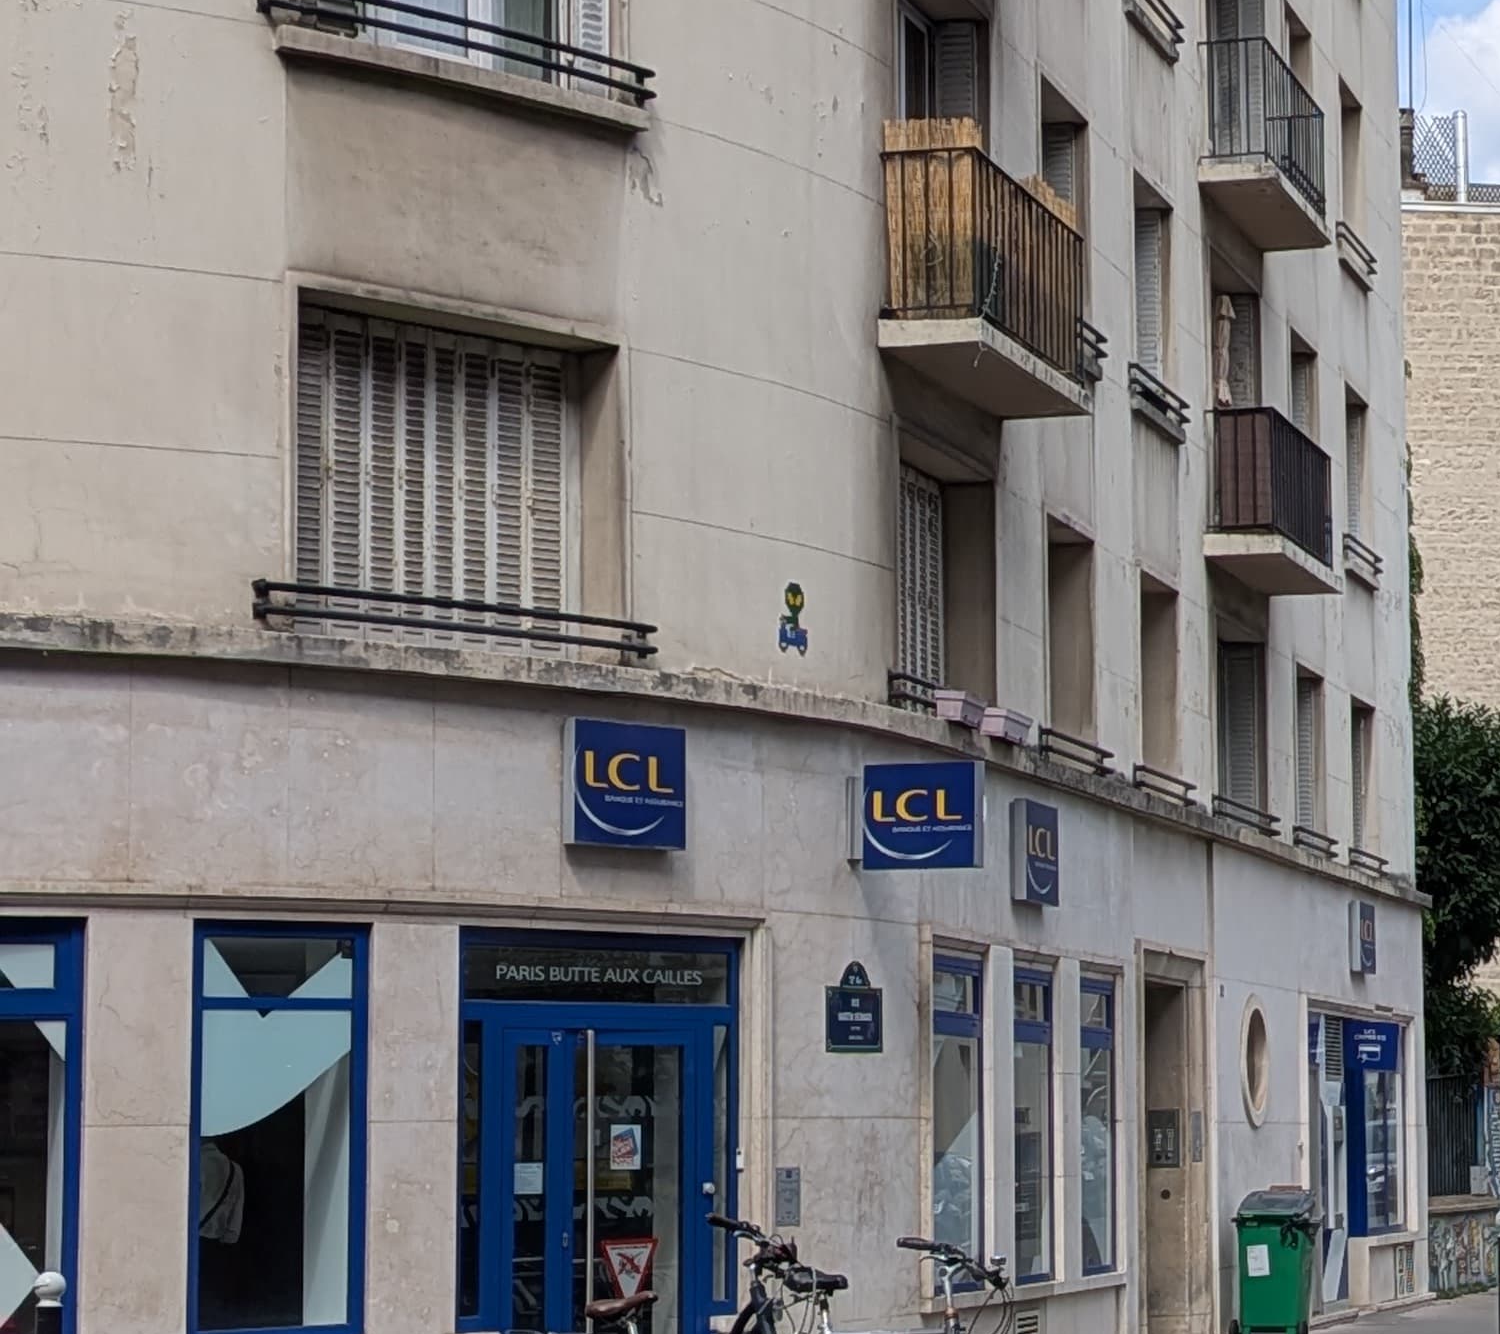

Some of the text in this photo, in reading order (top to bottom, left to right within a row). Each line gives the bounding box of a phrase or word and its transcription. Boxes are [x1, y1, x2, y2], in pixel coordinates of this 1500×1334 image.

[584, 750, 674, 793] LCL
[872, 789, 962, 822] LCL
[1028, 825, 1056, 860] LCL
[495, 964, 703, 986] PARIS BUTTE AUX CAILLES
